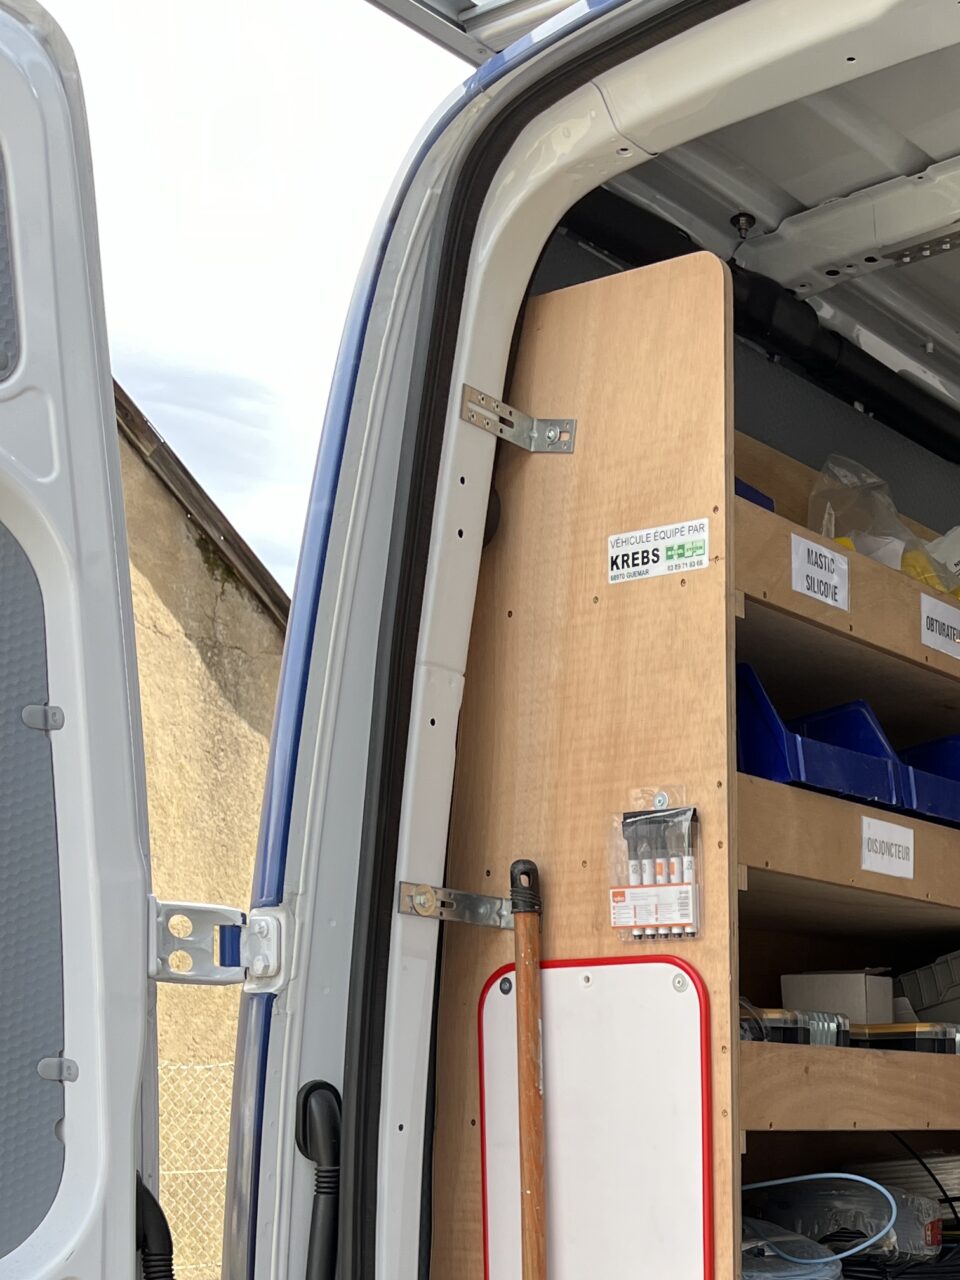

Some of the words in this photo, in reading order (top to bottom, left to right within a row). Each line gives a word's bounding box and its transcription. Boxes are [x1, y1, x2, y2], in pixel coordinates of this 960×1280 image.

[610, 533, 651, 549] VÉHICULE
[653, 526, 685, 541] ÉQUIPÉ
[688, 523, 705, 536] PAR
[610, 548, 660, 571] KREBS
[807, 548, 835, 574] MASTIC
[805, 574, 838, 602] SILICONE
[867, 837, 911, 861] DISJONCTEUR
